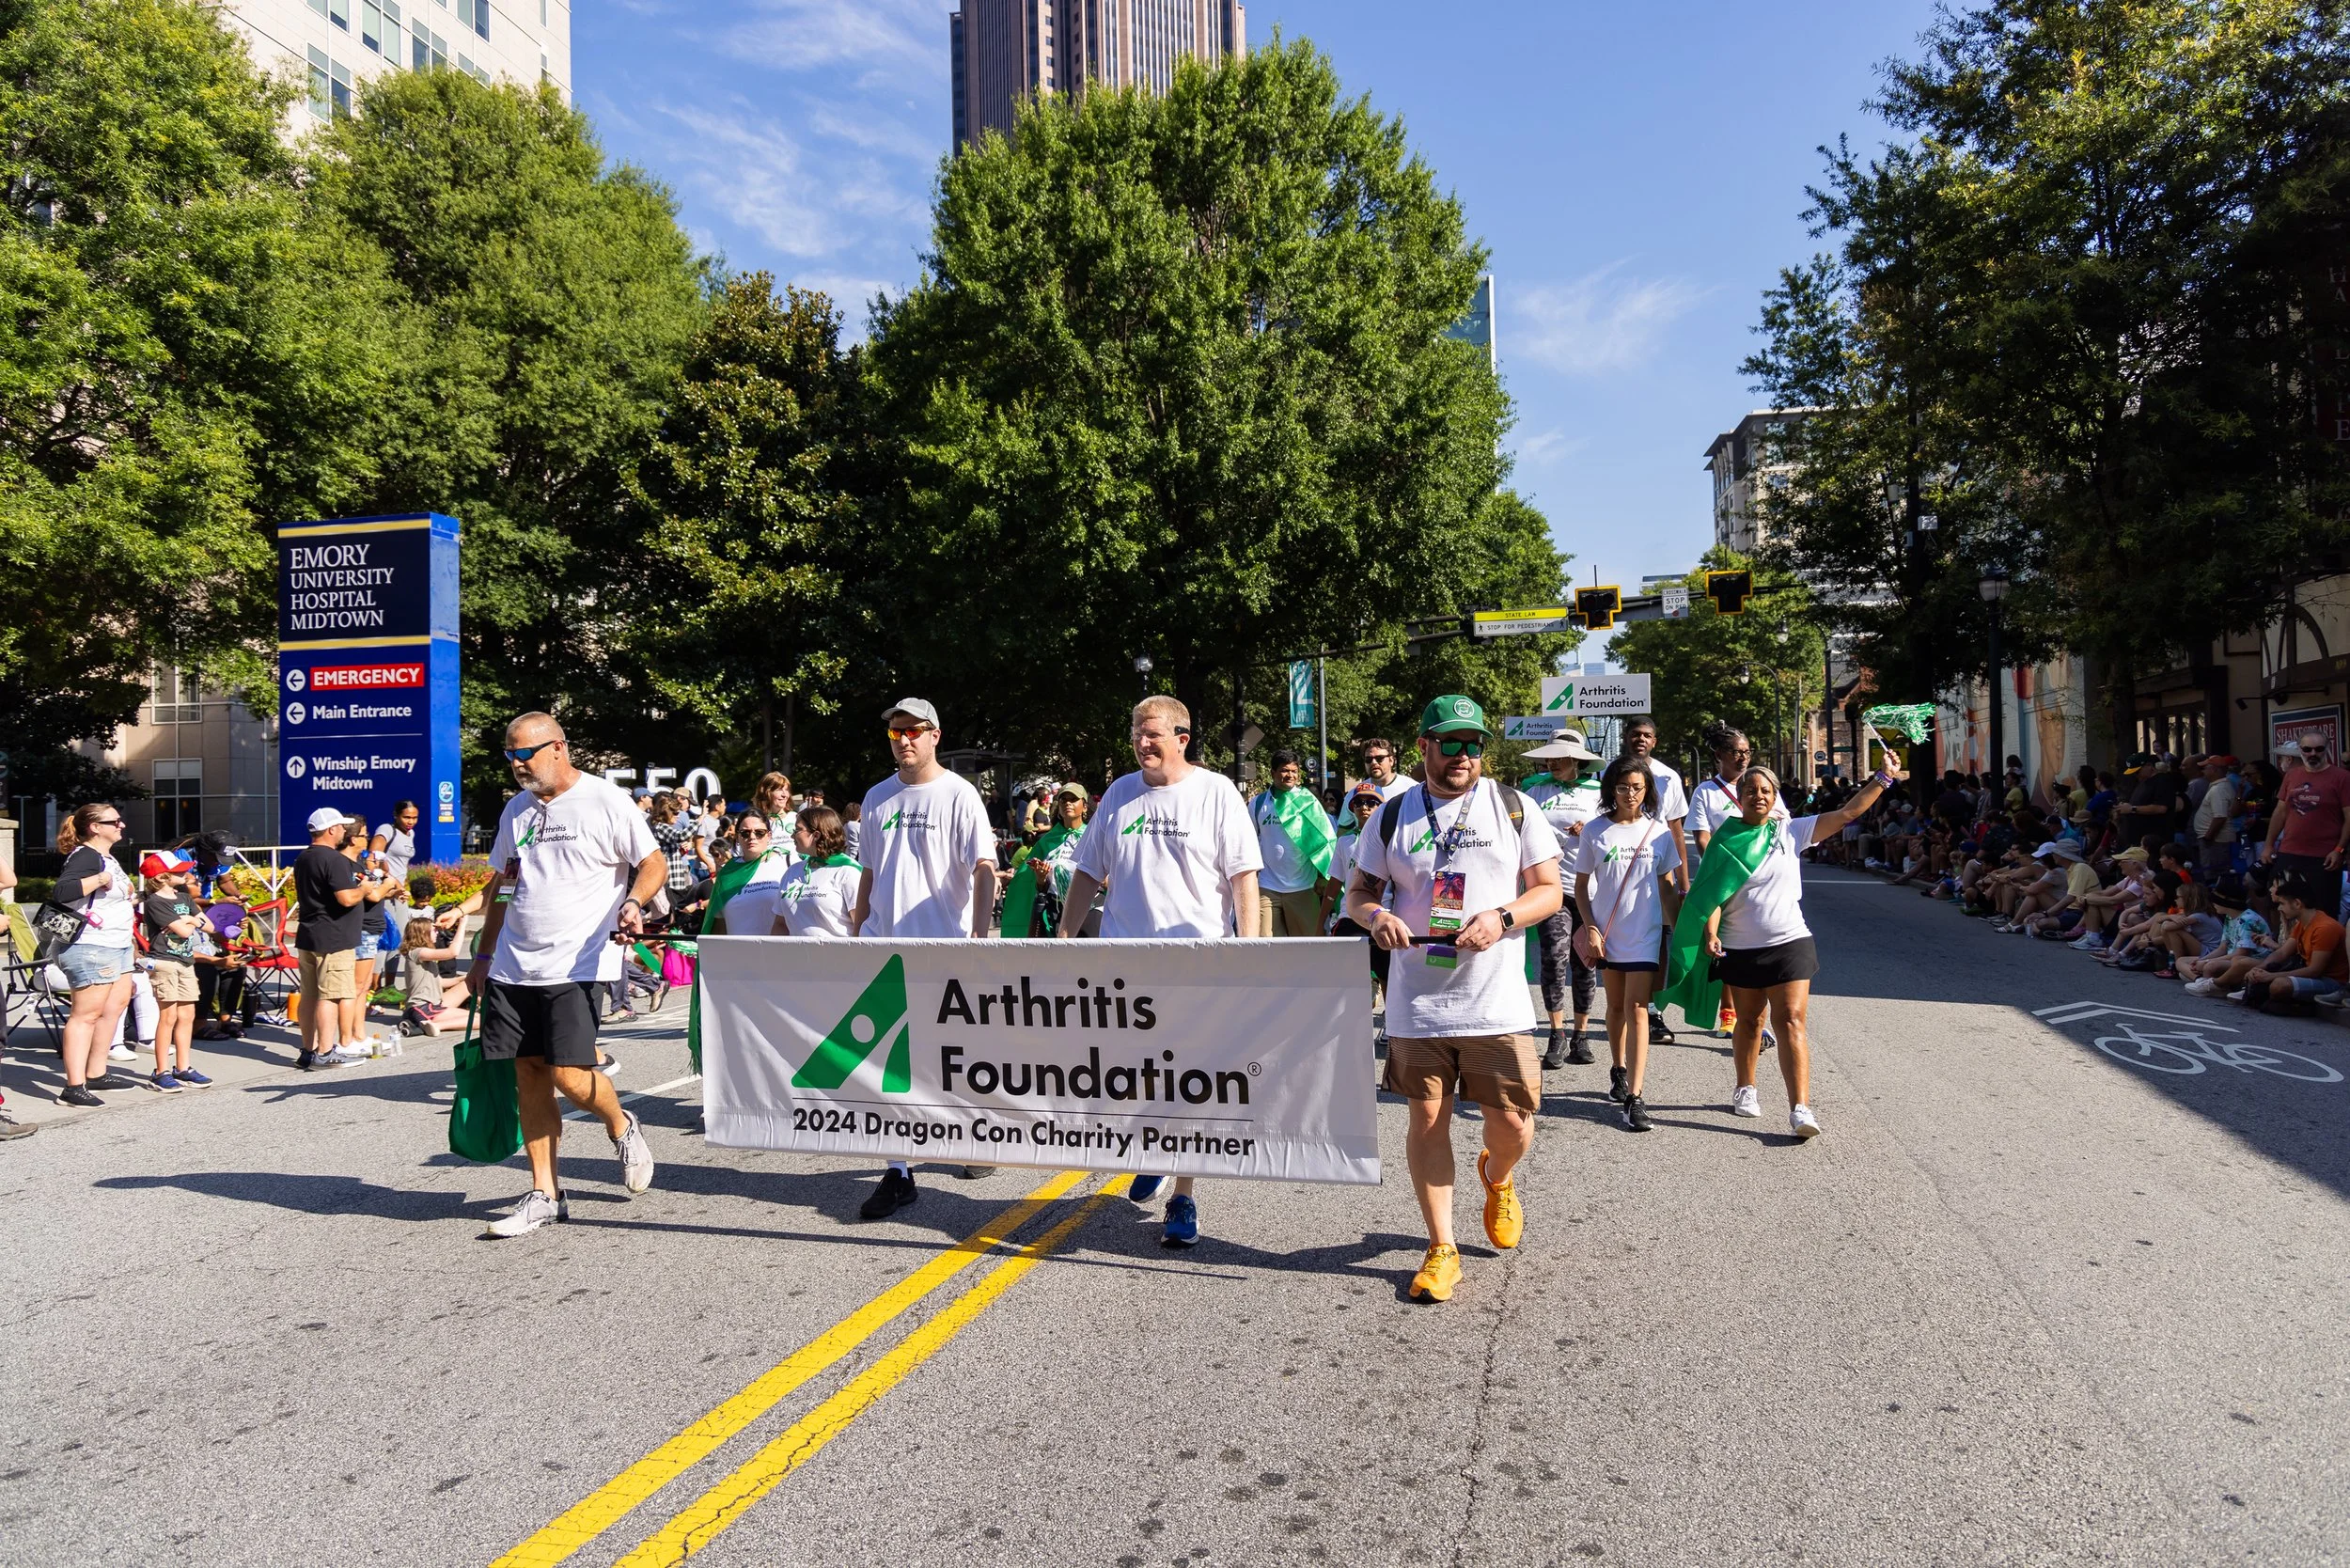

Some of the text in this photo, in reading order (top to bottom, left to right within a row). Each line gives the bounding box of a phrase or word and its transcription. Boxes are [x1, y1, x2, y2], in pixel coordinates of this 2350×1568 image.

[290, 543, 370, 570] EMORY
[290, 567, 395, 589] UNIVERSITY
[290, 589, 376, 610] HOSPITAL
[290, 609, 384, 630] MIDTOWN
[313, 666, 421, 686] EMERGENCY
[1579, 684, 1626, 697] Arthritis
[312, 704, 412, 720] Main Entrance
[312, 755, 416, 774] Winship Emory
[312, 776, 373, 791] Midtown
[1146, 816, 1178, 826] Arthritis
[936, 976, 1157, 1030] Arthritis
[792, 1107, 1255, 1158] 2024 Dragon Con Charity Partner
